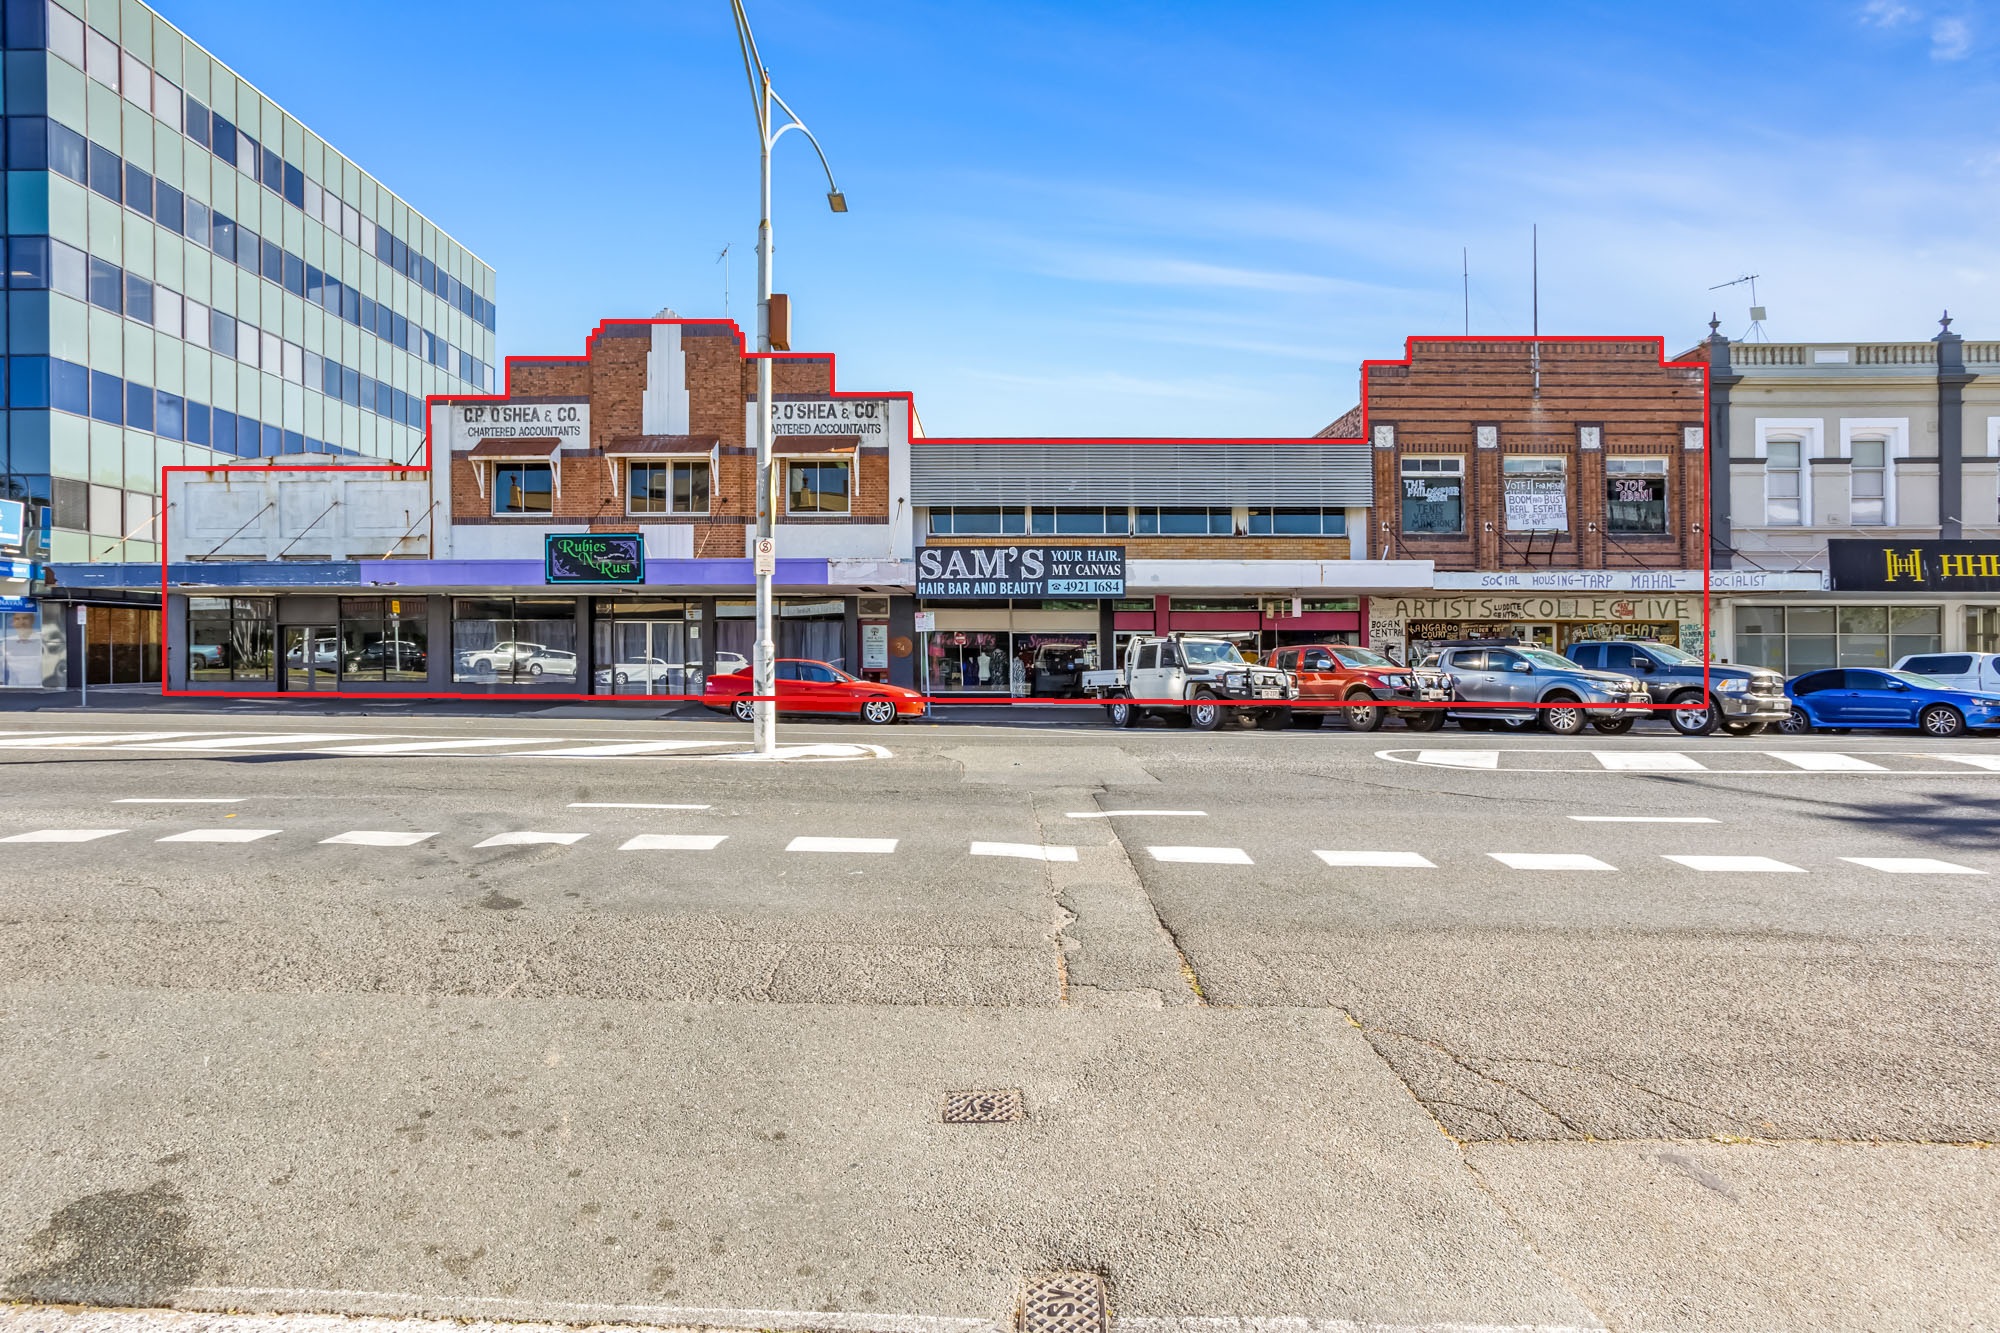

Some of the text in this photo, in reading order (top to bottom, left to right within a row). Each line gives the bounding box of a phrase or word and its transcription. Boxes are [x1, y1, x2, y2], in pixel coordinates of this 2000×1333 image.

[544, 409, 552, 423] &
[557, 406, 581, 422] CO.
[784, 403, 837, 420] O'SHEA
[841, 407, 849, 420] &
[854, 403, 878, 418] CO.
[467, 425, 581, 437] CHARTERED ACCOUNTANTS
[813, 423, 881, 434] ACCOUNTANTS
[1403, 479, 1425, 489] THE
[1615, 479, 1646, 491] STOP
[1508, 495, 1532, 505] BOOM
[1544, 494, 1565, 504] BUST
[1509, 504, 1564, 514] REAL ESTATE
[558, 540, 607, 558] Rubies
[596, 561, 631, 579] Rust
[1051, 550, 1121, 562] YOUR HAIR.
[918, 546, 1046, 581] SAM'S
[1052, 564, 1121, 576] MY CANVAS
[1064, 580, 1120, 593] 4921 1684
[1481, 575, 1520, 587] SOCIAL
[1709, 574, 1767, 587] SOCIALIST
[918, 582, 1043, 595] HAIR BAR AND BEAUTY
[1394, 599, 1493, 618] ARTISTS
[1522, 598, 1690, 620] COLLECTIVE
[1493, 602, 1523, 611] LUDDITE
[1371, 620, 1401, 629] BOGAN
[1408, 623, 1459, 634] KANGAROO
[1369, 628, 1407, 638] CENTRAL
[1623, 623, 1659, 639] CHAT
